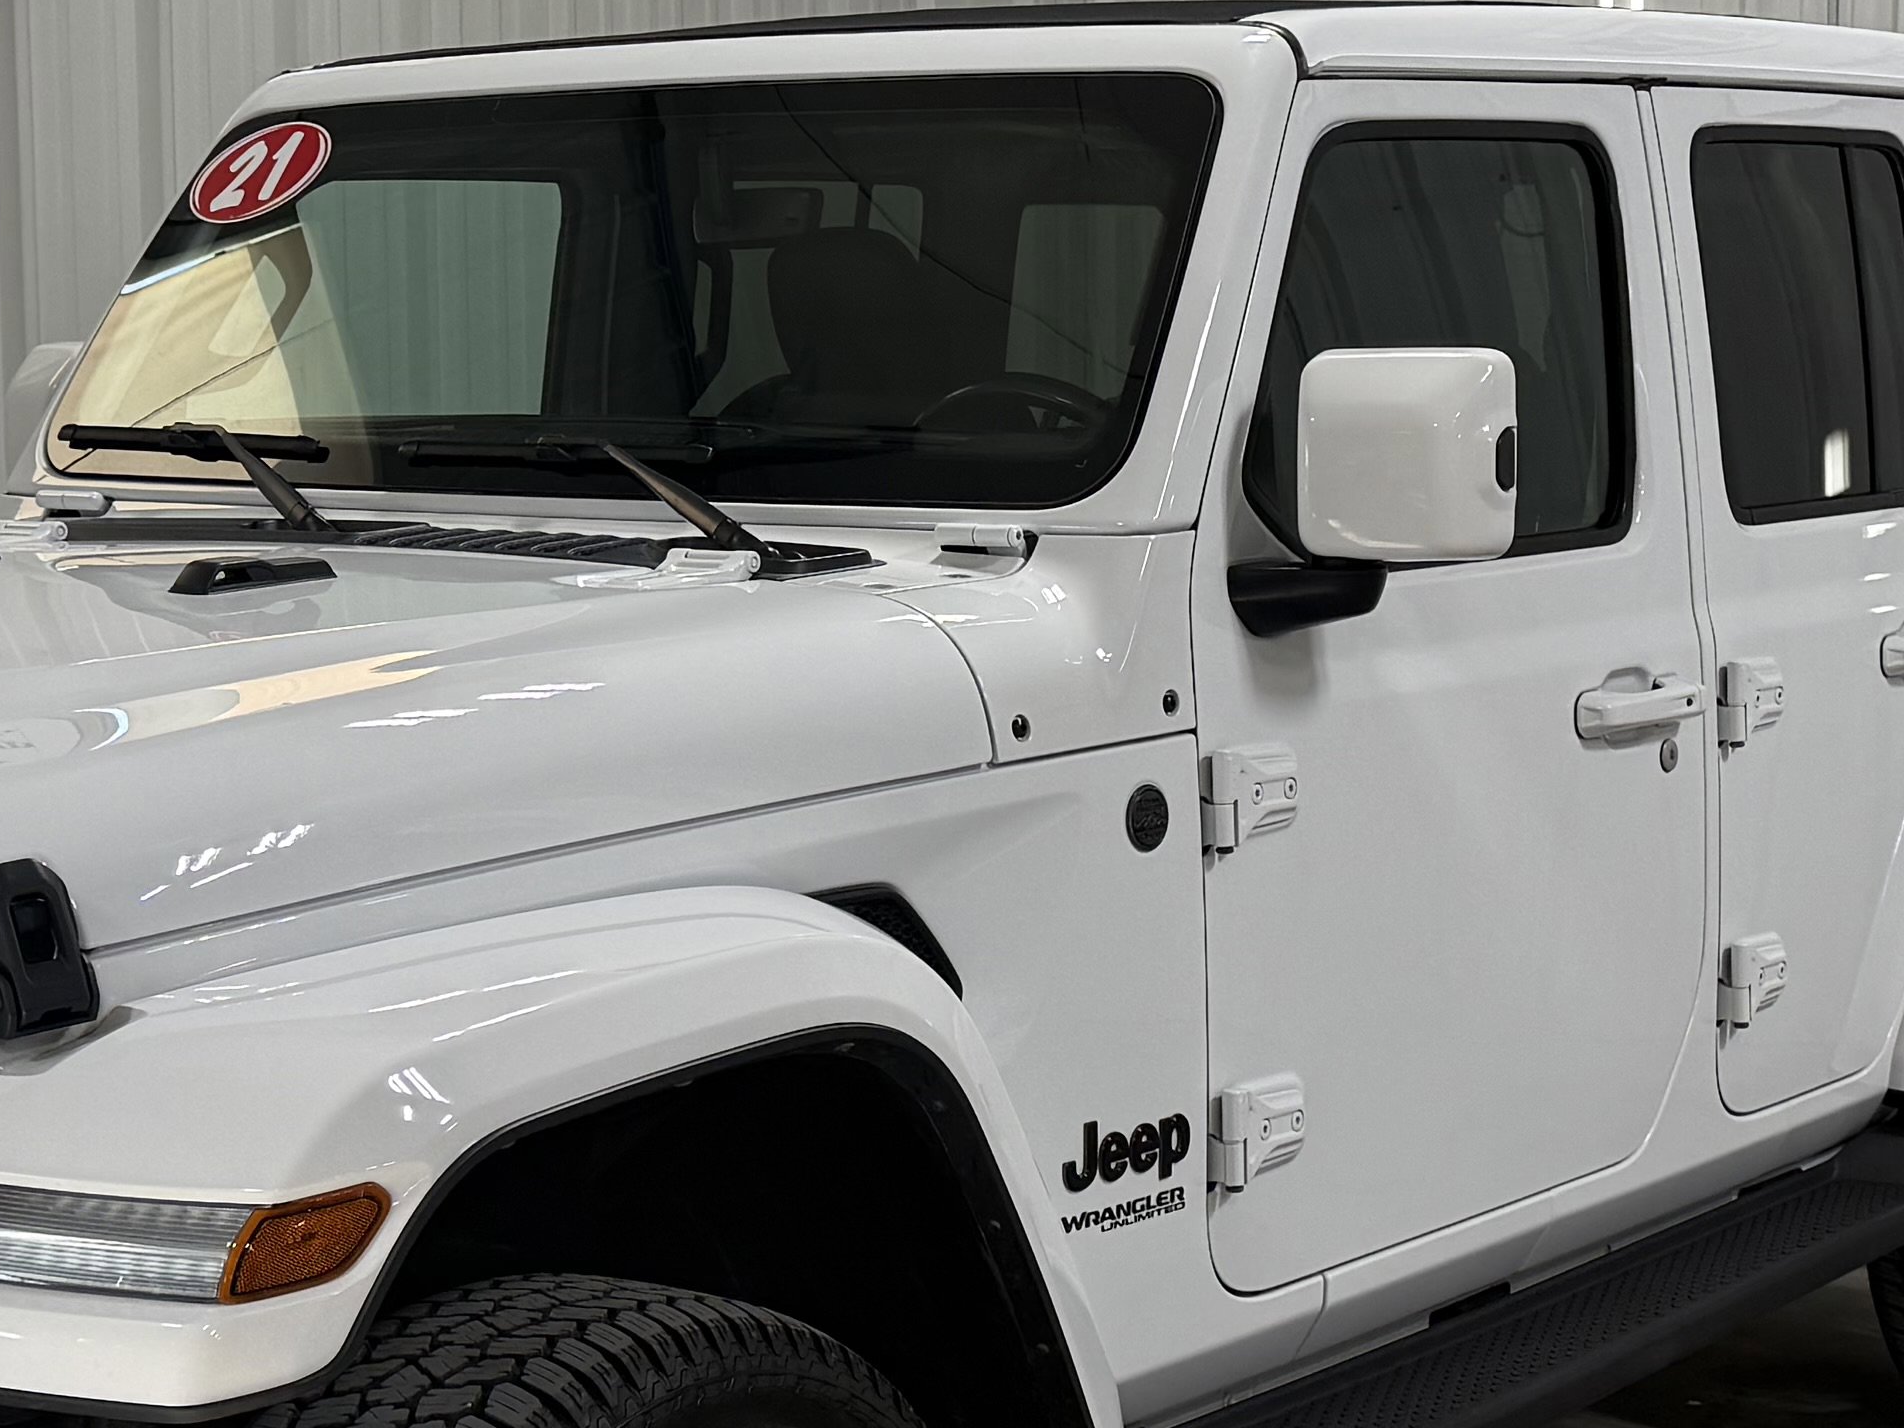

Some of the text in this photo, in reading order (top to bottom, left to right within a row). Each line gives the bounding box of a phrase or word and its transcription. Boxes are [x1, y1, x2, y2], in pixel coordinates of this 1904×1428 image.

[209, 131, 305, 213] 21
[1062, 1113, 1191, 1193] Jeep
[1061, 1186, 1186, 1234] WRANGLER
[1100, 1201, 1186, 1233] UNLIMITED
